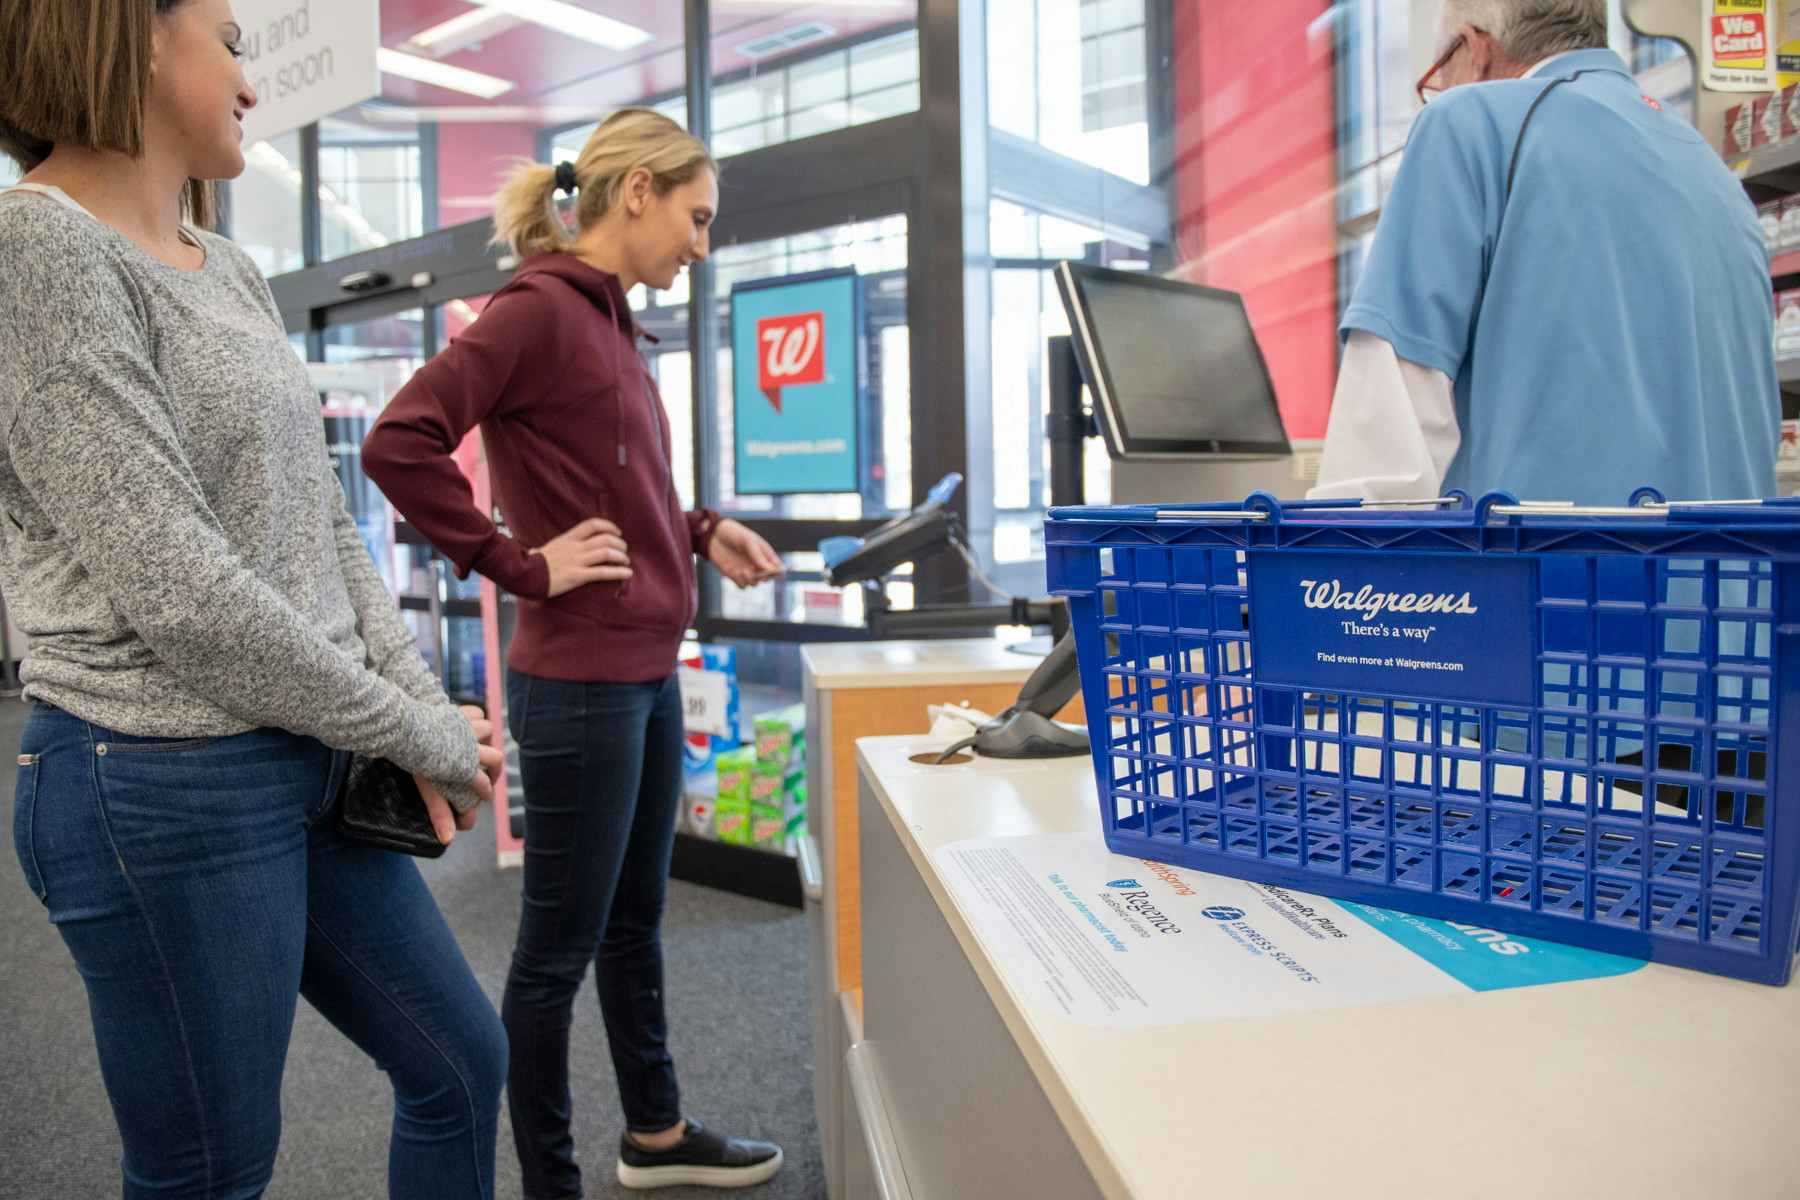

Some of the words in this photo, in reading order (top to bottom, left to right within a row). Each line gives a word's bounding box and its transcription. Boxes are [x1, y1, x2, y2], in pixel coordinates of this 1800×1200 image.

[268, 0, 309, 53] and
[1720, 16, 1756, 34] We
[1714, 32, 1764, 53] Card
[276, 45, 334, 97] soon
[761, 318, 820, 377] W
[1300, 579, 1478, 621] Walgreens
[1341, 621, 1390, 637] There's
[1392, 628, 1401, 638] a
[1317, 652, 1336, 663] Find
[1337, 655, 1358, 665] even
[1359, 657, 1383, 667] more
[1384, 658, 1394, 667] at
[1395, 658, 1464, 673] Walgreens.com
[1119, 891, 1182, 935] Regence
[1311, 917, 1348, 938] Plans
[1232, 921, 1277, 950] EXPRESS
